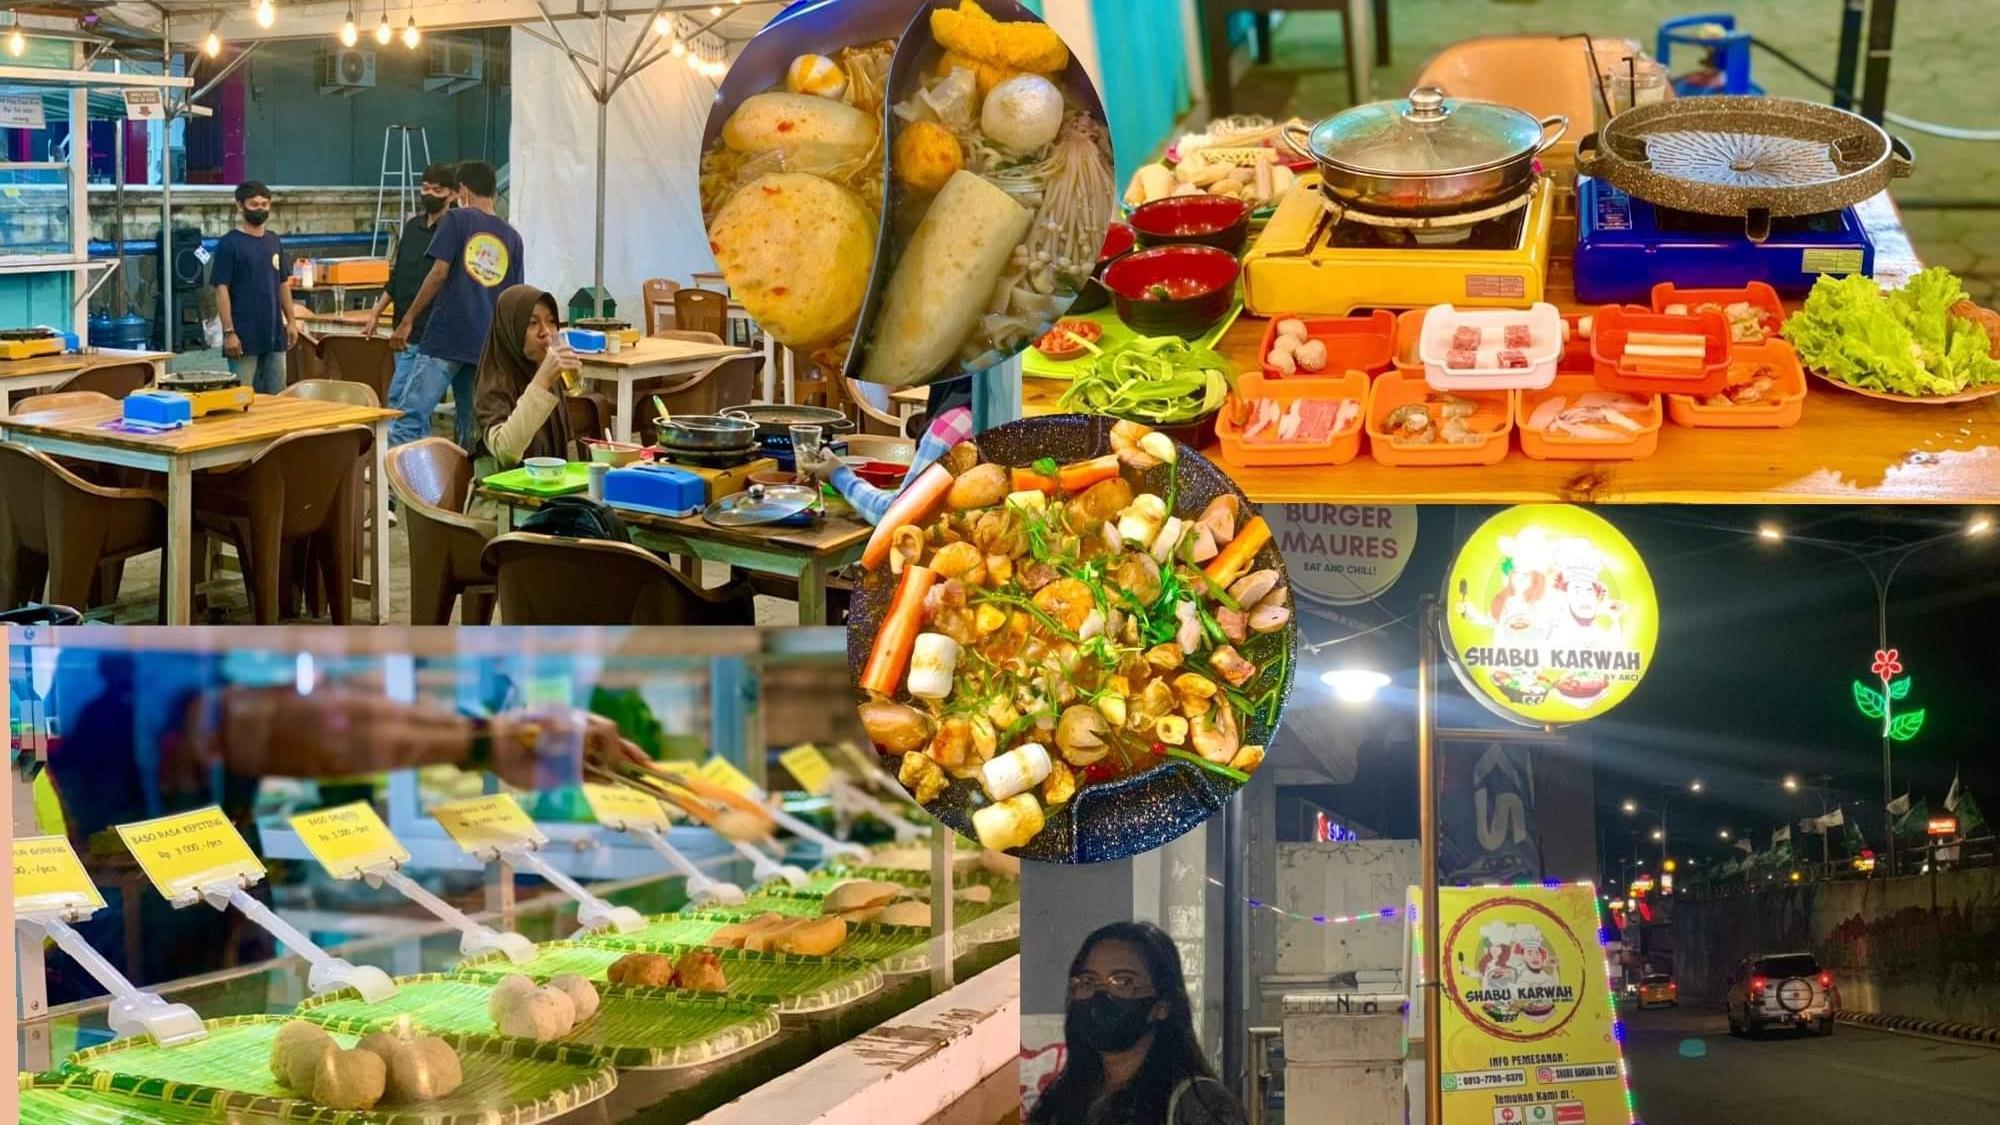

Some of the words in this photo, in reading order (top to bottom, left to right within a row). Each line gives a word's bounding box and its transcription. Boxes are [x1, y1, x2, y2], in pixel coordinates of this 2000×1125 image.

[1286, 503, 1392, 529] BURGER
[1280, 531, 1398, 560] MAURES
[1304, 562, 1322, 572] EAT
[1324, 563, 1344, 574] AND
[1347, 565, 1377, 576] CHILL!
[1465, 647, 1539, 667] SHABU
[1551, 649, 1641, 671] KARWAH
[1465, 987, 1511, 1003] SHABU
[1518, 985, 1573, 1000] KARWAH
[1489, 1056, 1508, 1068] INFO
[1511, 1053, 1564, 1067] PEMESANAN
[1495, 1093, 1534, 1104] Temukan
[1536, 1090, 1558, 1101] Kami
